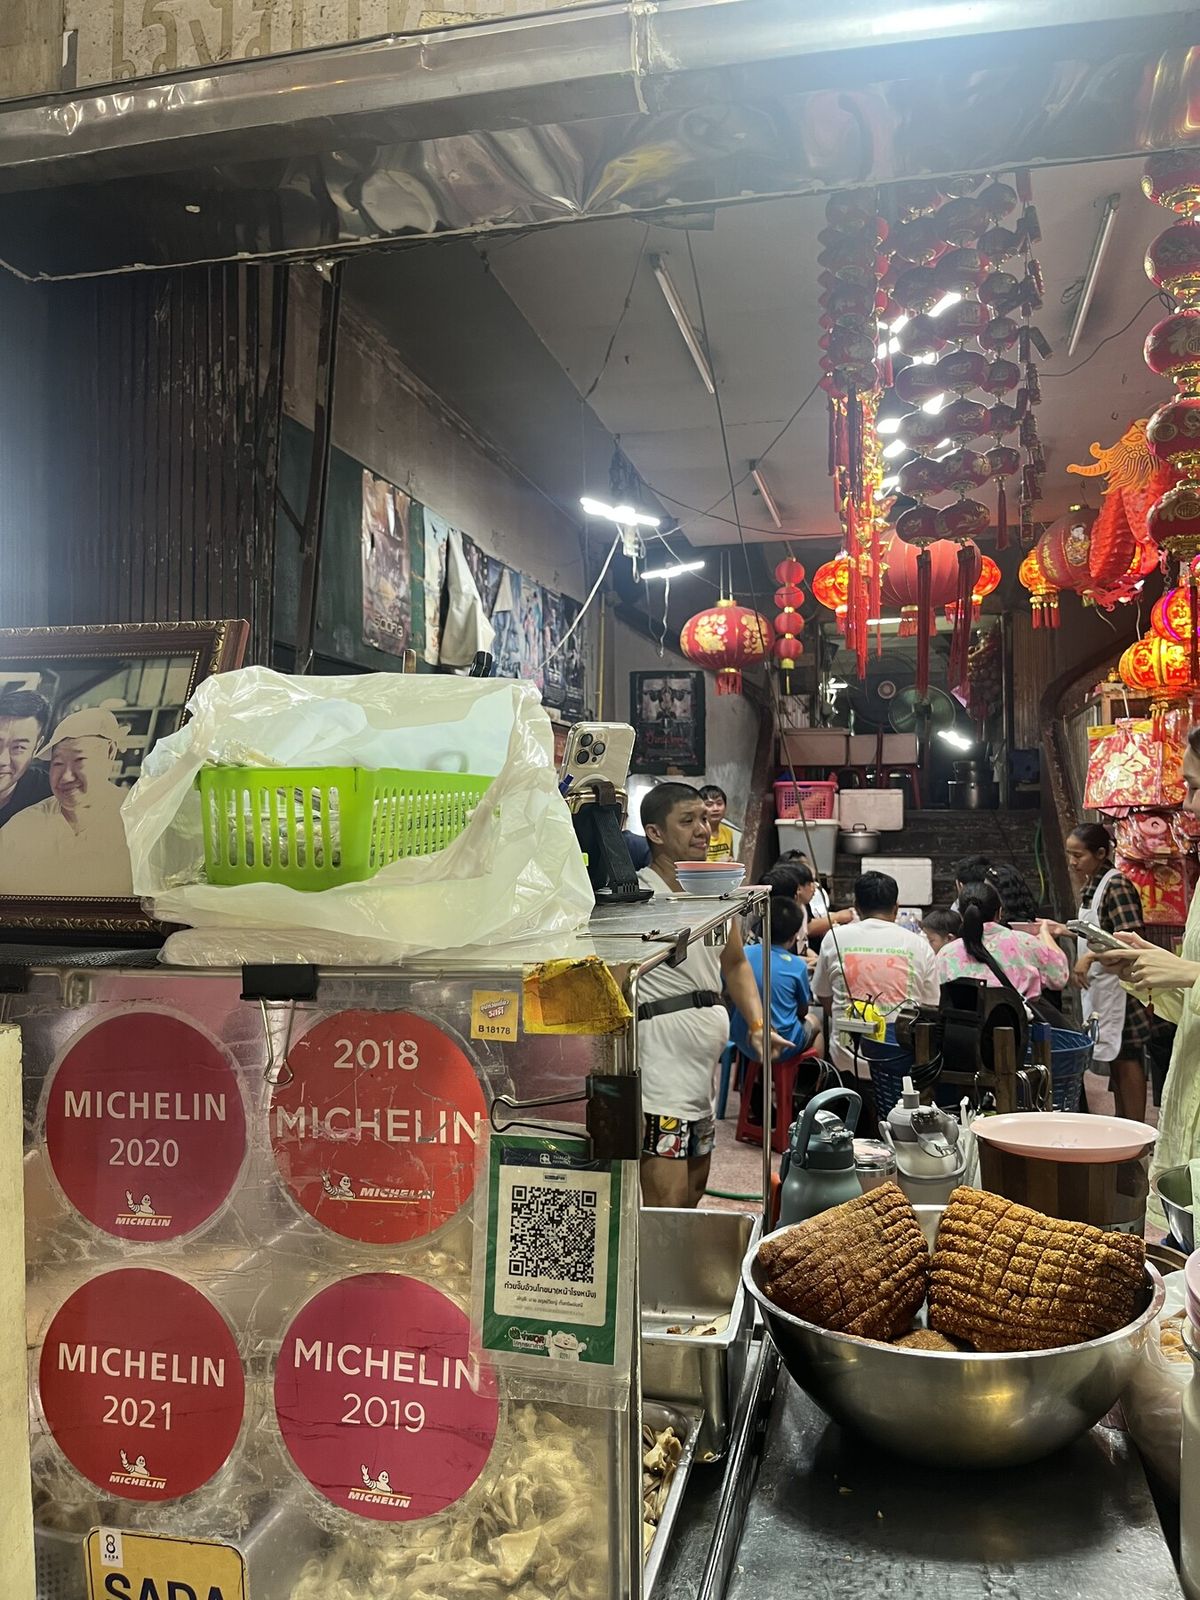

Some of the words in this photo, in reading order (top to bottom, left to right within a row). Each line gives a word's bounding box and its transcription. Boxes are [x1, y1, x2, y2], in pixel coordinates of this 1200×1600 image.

[334, 1039, 419, 1070] 2018
[65, 1091, 226, 1121] MICHELIN
[276, 1105, 481, 1145] MICHELIN
[109, 1138, 180, 1167] 2020
[360, 1187, 435, 1200] MICHELIN
[115, 1217, 171, 1227] MICHELIN
[58, 1343, 225, 1387] MICHELIN
[294, 1338, 480, 1391] MICHELIN
[103, 1395, 171, 1430] 2021
[341, 1393, 425, 1433] 2019
[109, 1475, 167, 1489] MICHELIN
[347, 1491, 411, 1508] MICHELIN
